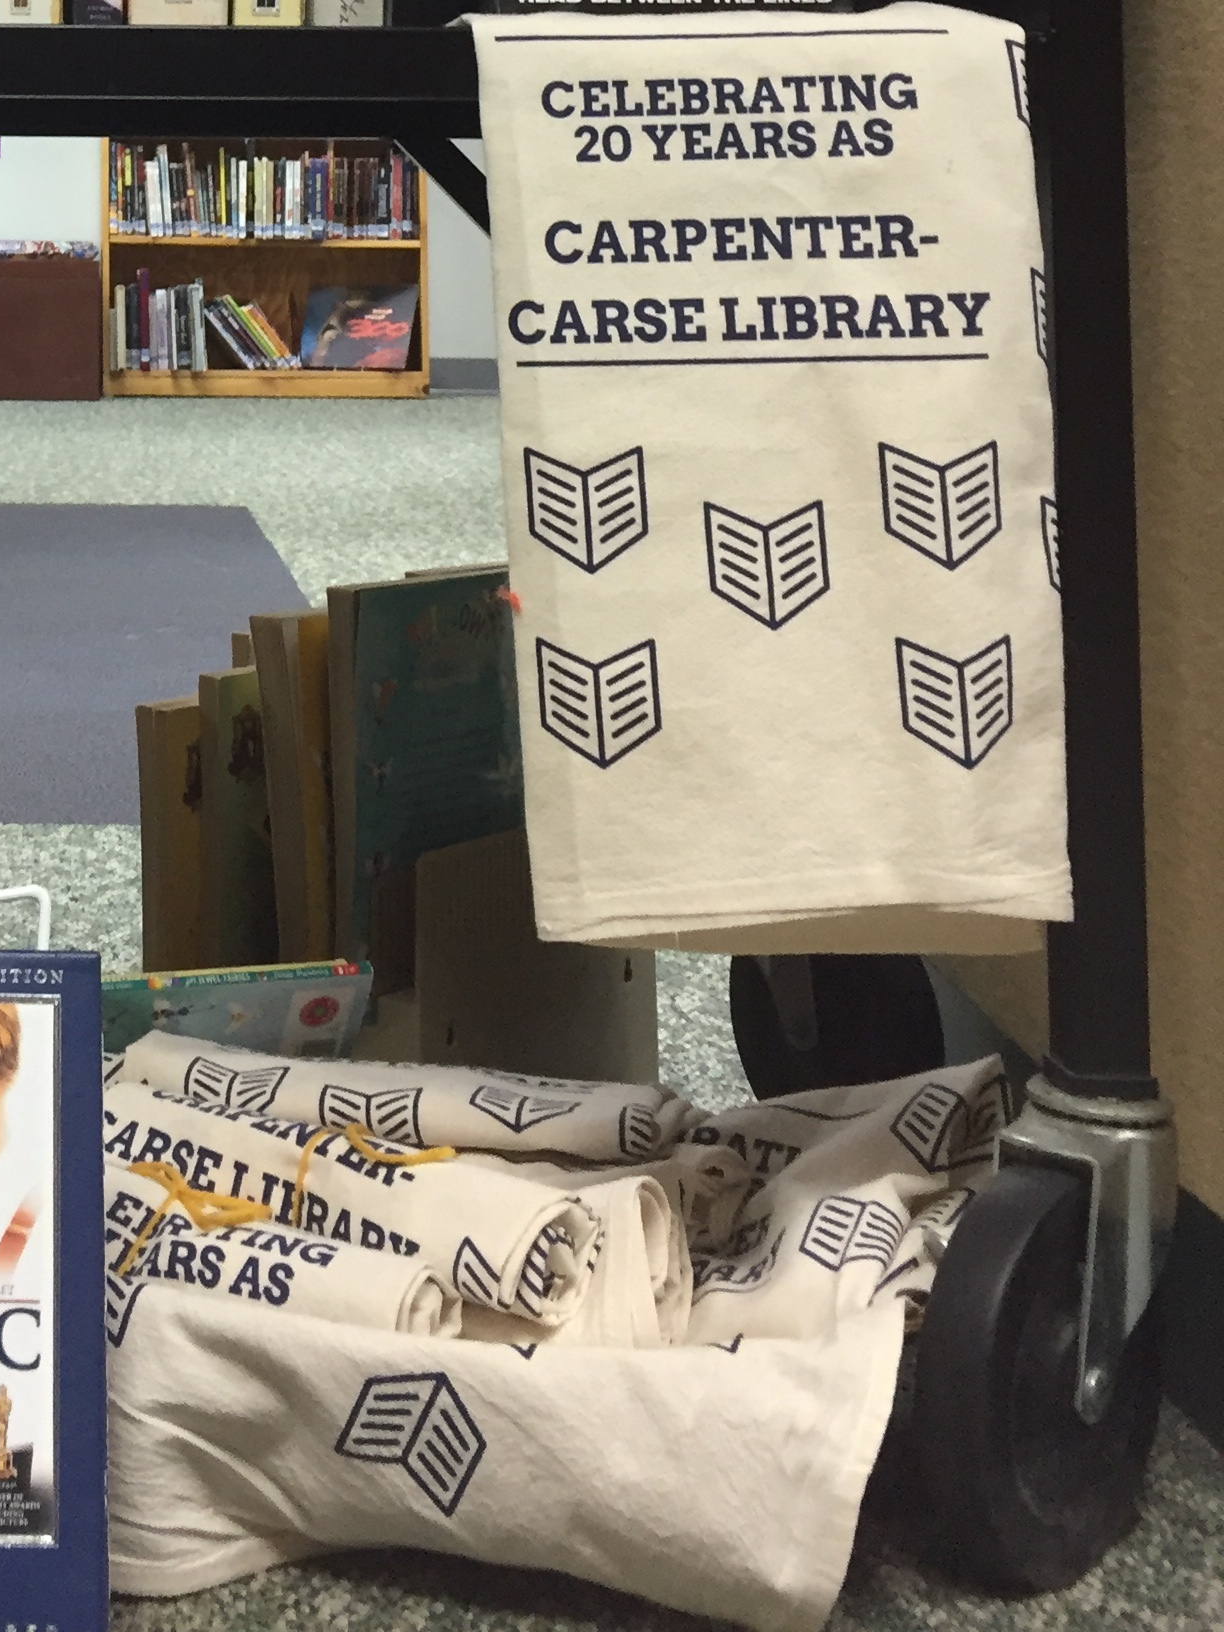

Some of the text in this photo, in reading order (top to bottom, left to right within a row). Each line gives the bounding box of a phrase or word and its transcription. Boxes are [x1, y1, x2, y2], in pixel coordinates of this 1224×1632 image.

[540, 71, 920, 119] CELEBRATING
[573, 118, 895, 164] 20 YEARS AS
[543, 214, 941, 265] CARPENTER-
[507, 291, 992, 346] CARSE LIBRARY
[104, 1109, 219, 1196] ARSE
